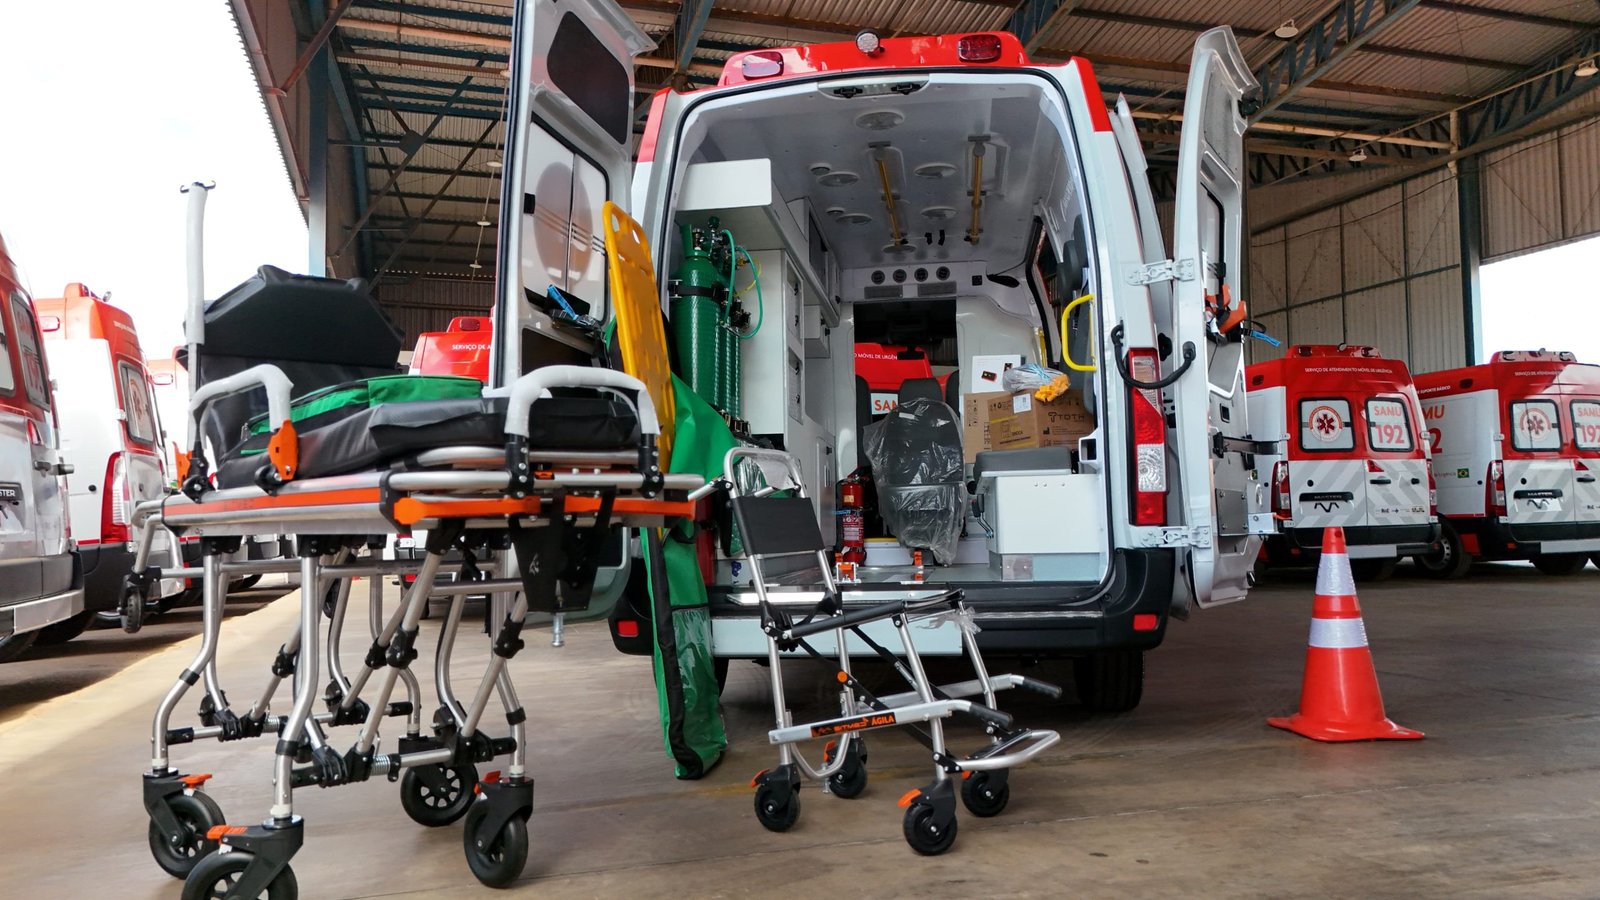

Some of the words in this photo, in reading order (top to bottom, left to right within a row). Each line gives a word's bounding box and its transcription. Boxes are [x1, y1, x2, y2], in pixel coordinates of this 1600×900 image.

[1374, 406, 1402, 416] SAMU
[1422, 405, 1445, 419] MU
[1375, 425, 1405, 443] 192
